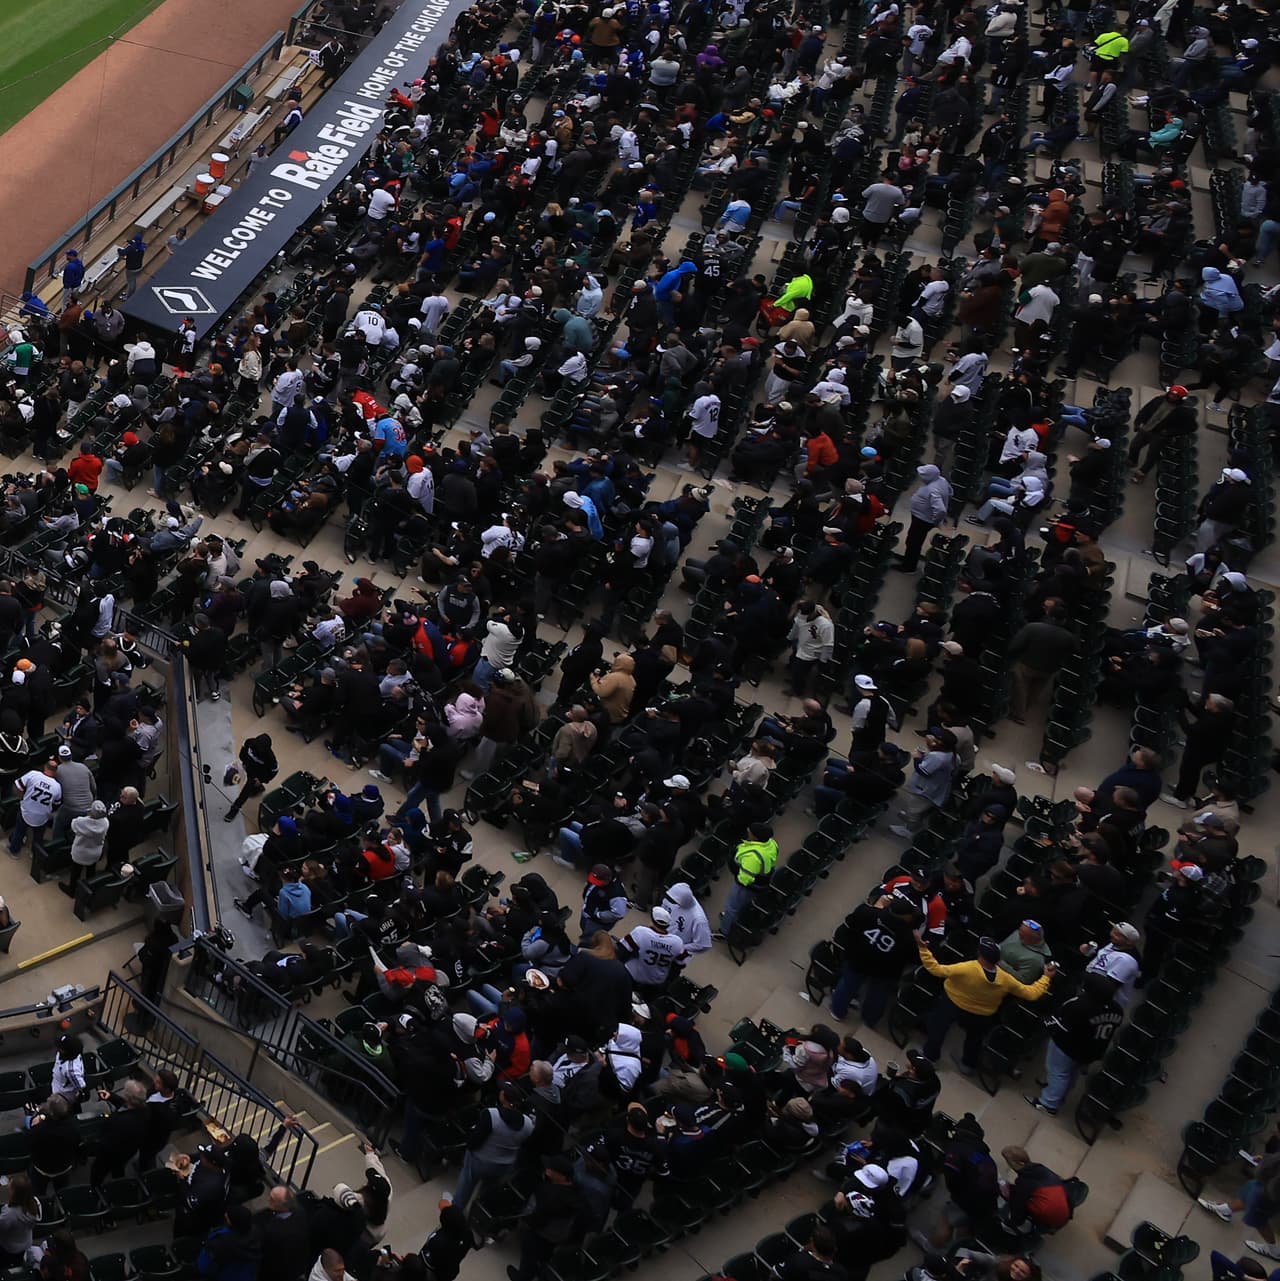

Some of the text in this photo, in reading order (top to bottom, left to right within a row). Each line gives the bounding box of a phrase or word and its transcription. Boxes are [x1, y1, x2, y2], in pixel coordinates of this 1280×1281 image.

[395, 31, 427, 53] THE
[383, 52, 409, 68] OF
[357, 65, 398, 101] HOME
[317, 101, 383, 151] Field
[270, 140, 349, 191] Rate
[258, 187, 294, 216] TO
[190, 207, 276, 282] WELCOME
[704, 266, 720, 277] 45
[368, 316, 378, 326] 10
[30, 787, 52, 806] 72
[650, 940, 672, 952] THOMAS
[864, 928, 896, 952] 49
[644, 950, 674, 967] 35
